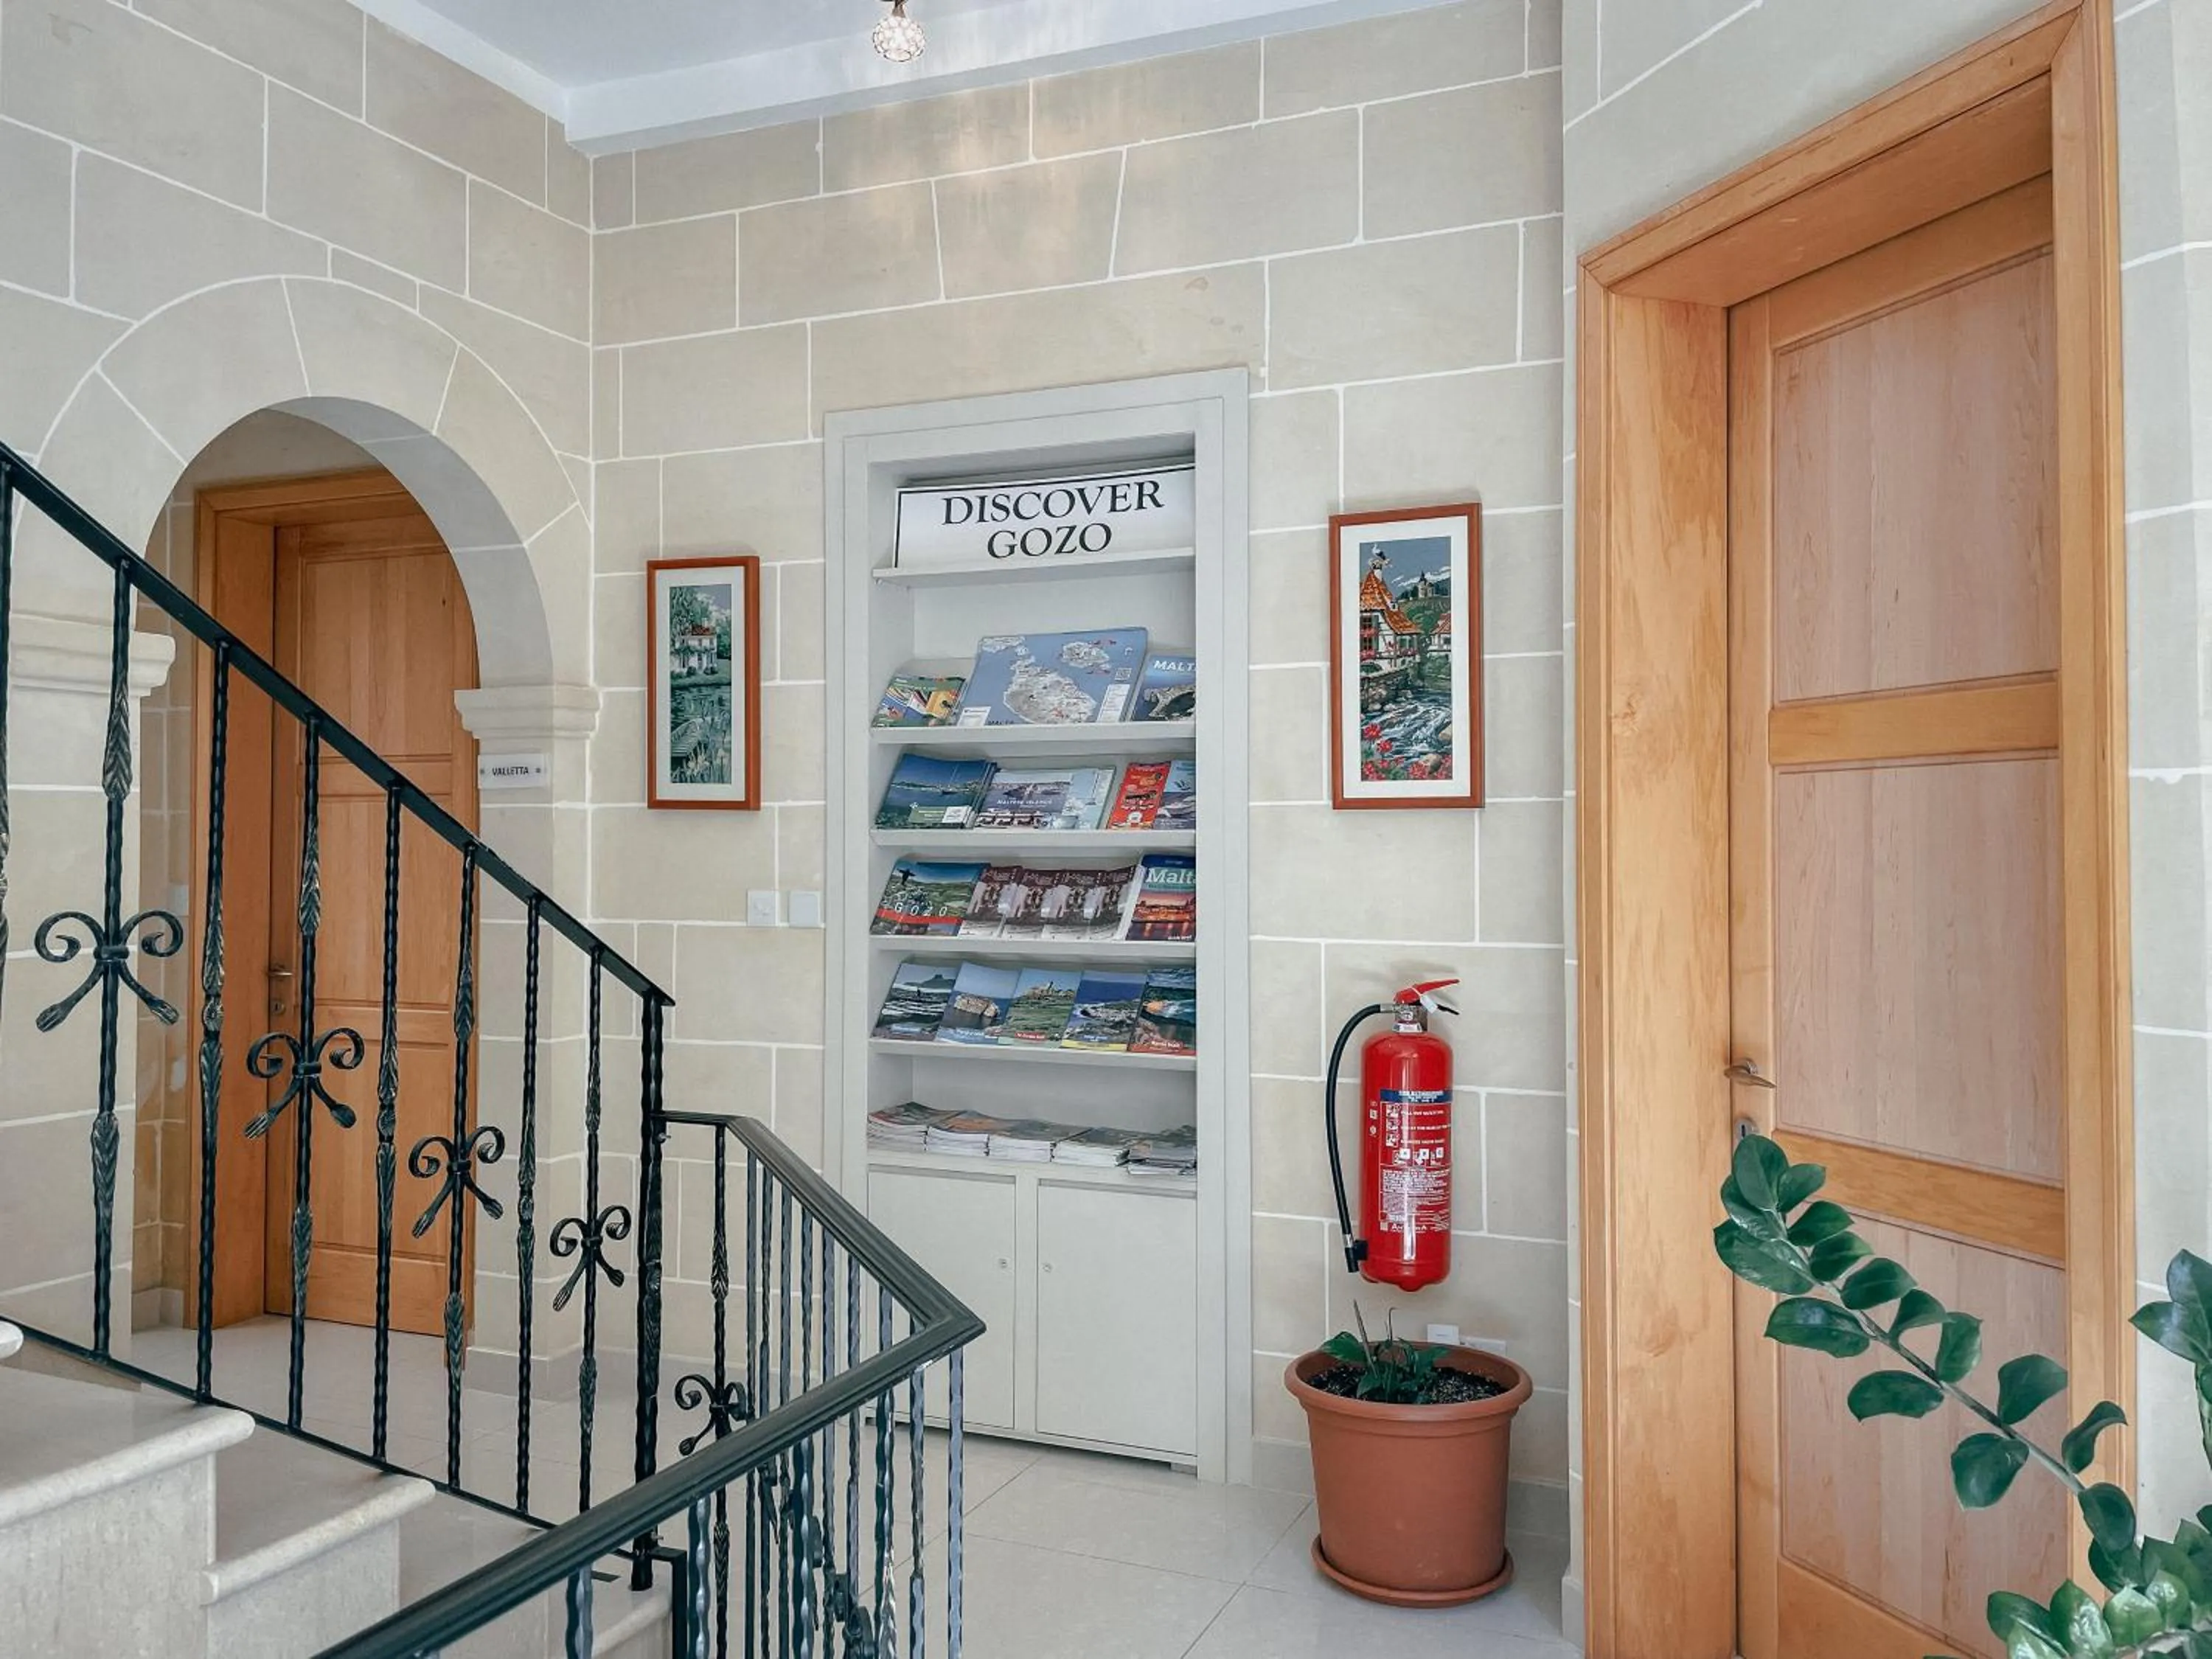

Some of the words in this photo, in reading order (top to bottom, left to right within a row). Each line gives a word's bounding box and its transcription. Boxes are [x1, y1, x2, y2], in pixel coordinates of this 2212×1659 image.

[942, 480, 1165, 526] DISCOVER
[987, 523, 1112, 559] GOZO
[1153, 660, 1196, 672] MALT
[492, 766, 529, 776] VALLETTA
[1145, 867, 1196, 884] Malt
[894, 902, 947, 917] GOZO
